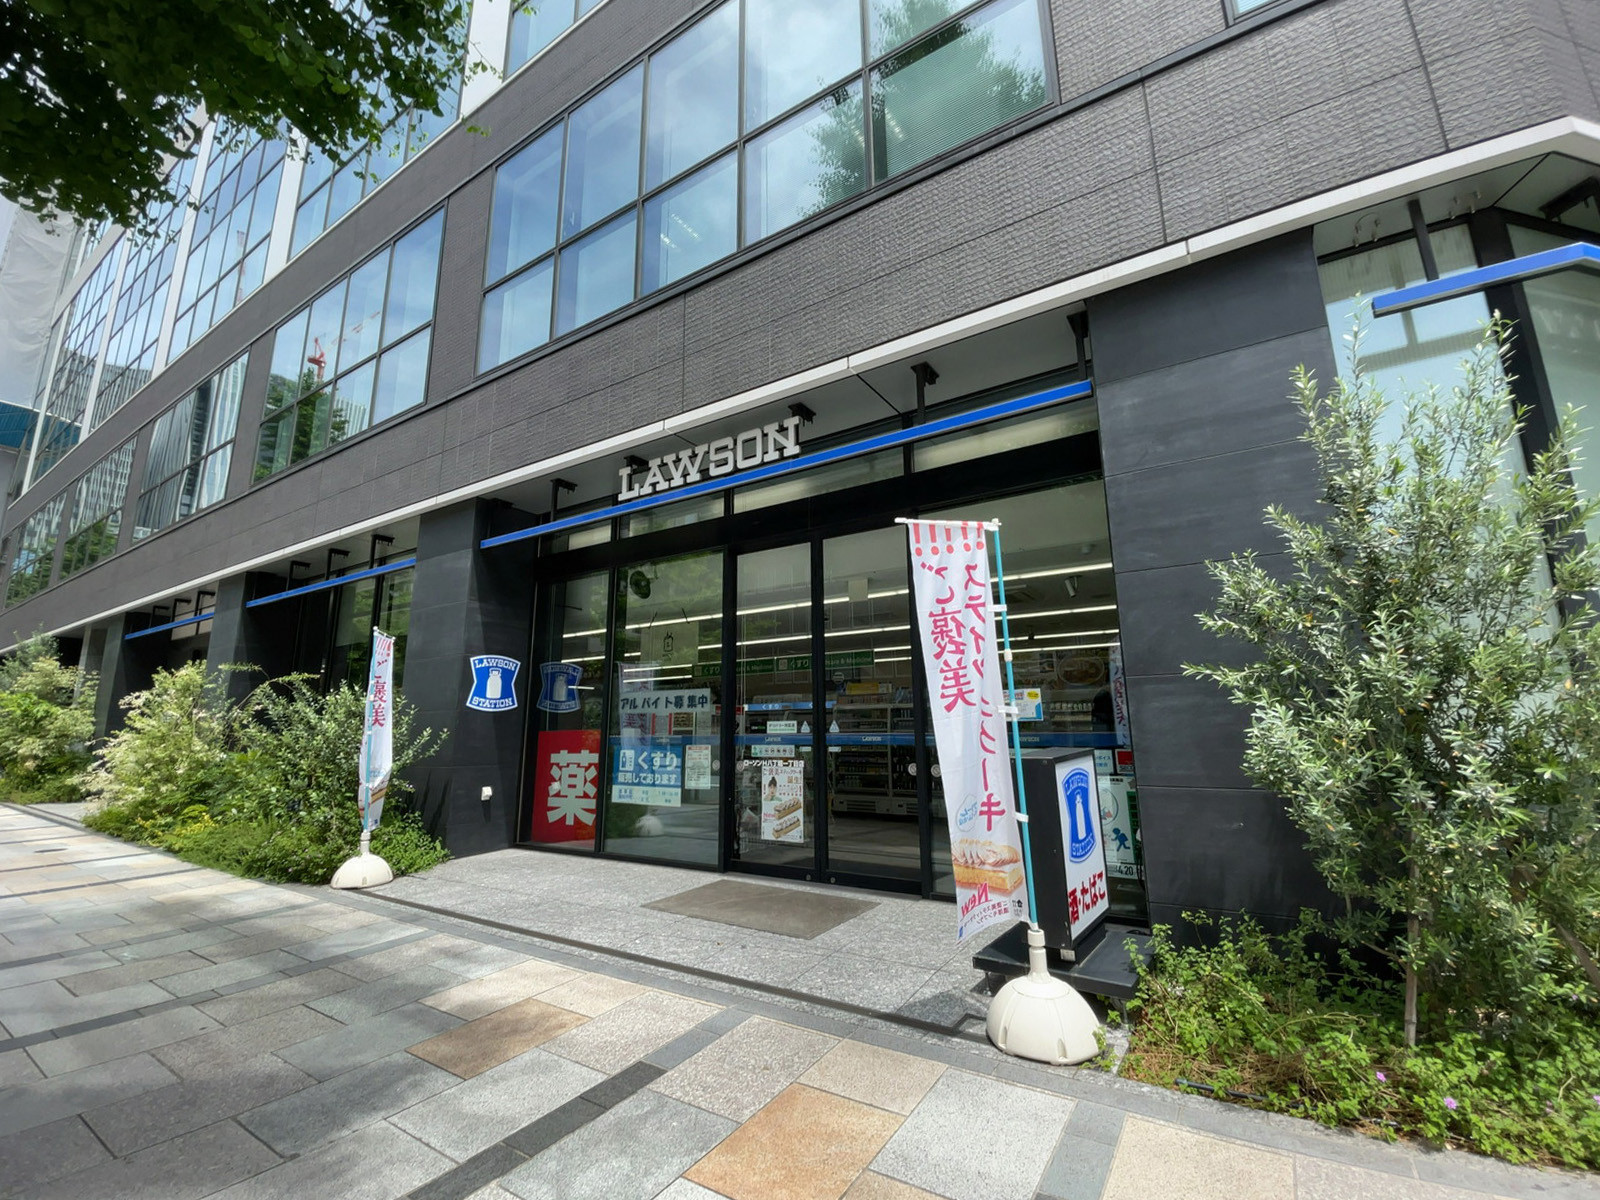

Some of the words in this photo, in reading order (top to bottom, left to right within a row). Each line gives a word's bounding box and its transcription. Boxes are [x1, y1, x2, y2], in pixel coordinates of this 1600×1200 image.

[618, 416, 800, 501] LAWSON
[475, 658, 516, 671] LAWSON
[790, 659, 809, 668] くすり
[472, 696, 513, 708] STATION
[620, 693, 708, 710] アルバイト募集中
[637, 751, 678, 770] くすり
[546, 749, 599, 826] 薬
[618, 772, 678, 785] 販売しております
[1066, 771, 1089, 796] LAWSON
[1071, 832, 1096, 858] STATION
[1067, 870, 1107, 925] 酒・たばこ
